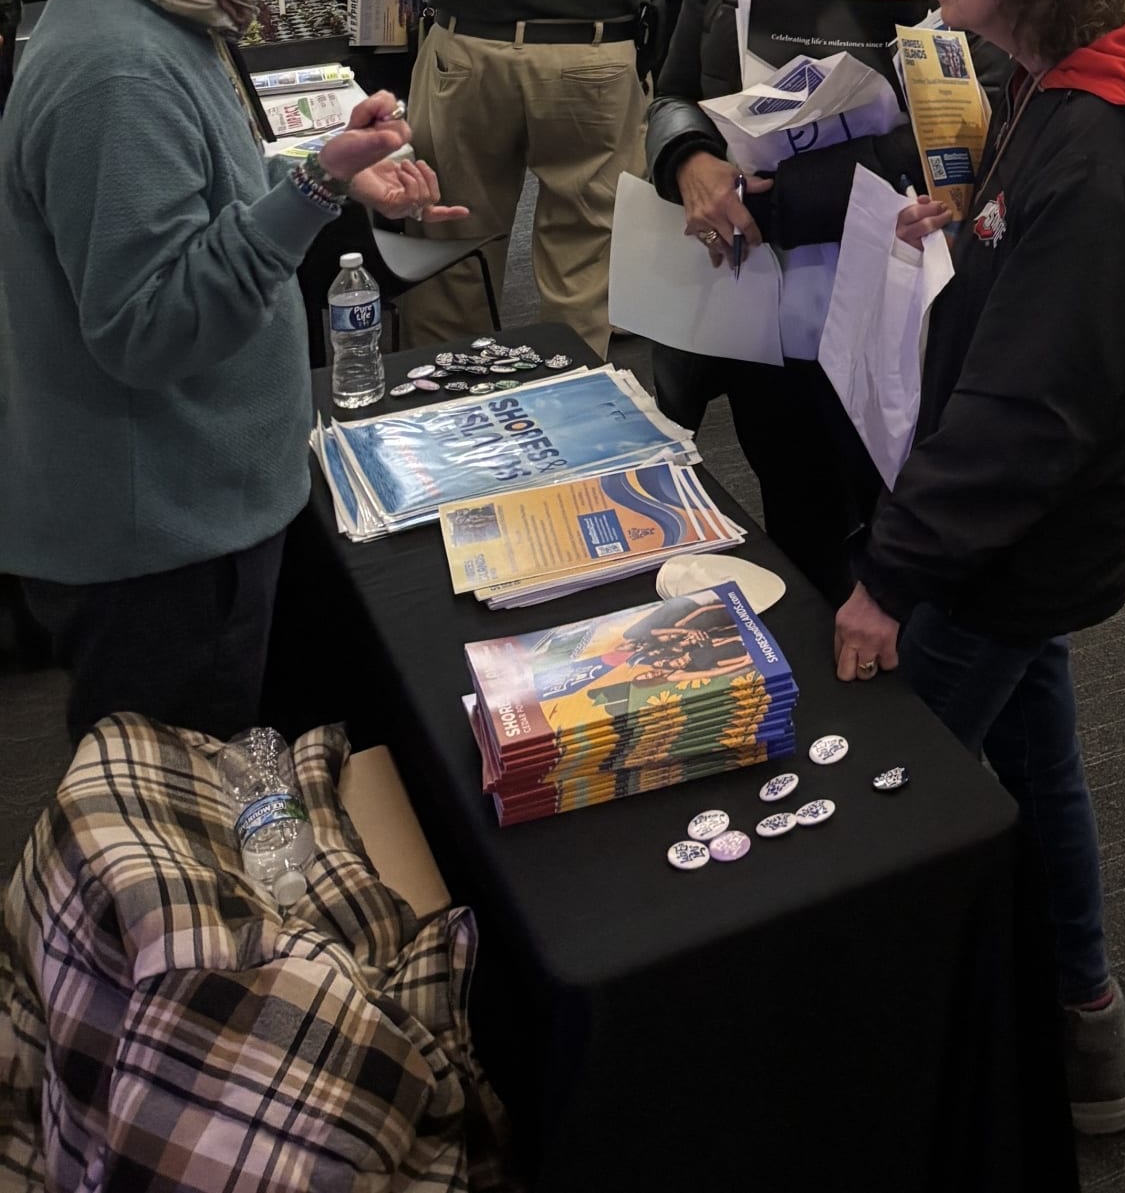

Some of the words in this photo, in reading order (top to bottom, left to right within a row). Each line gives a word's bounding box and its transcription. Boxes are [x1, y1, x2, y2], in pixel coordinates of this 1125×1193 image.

[771, 33, 810, 46] Celebrating
[811, 37, 826, 46] life's
[827, 40, 865, 48] milestones
[353, 304, 373, 314] Pure
[356, 311, 371, 326] Life
[488, 398, 560, 463] SHORES
[728, 591, 779, 663] SHORESandISLANDS.com
